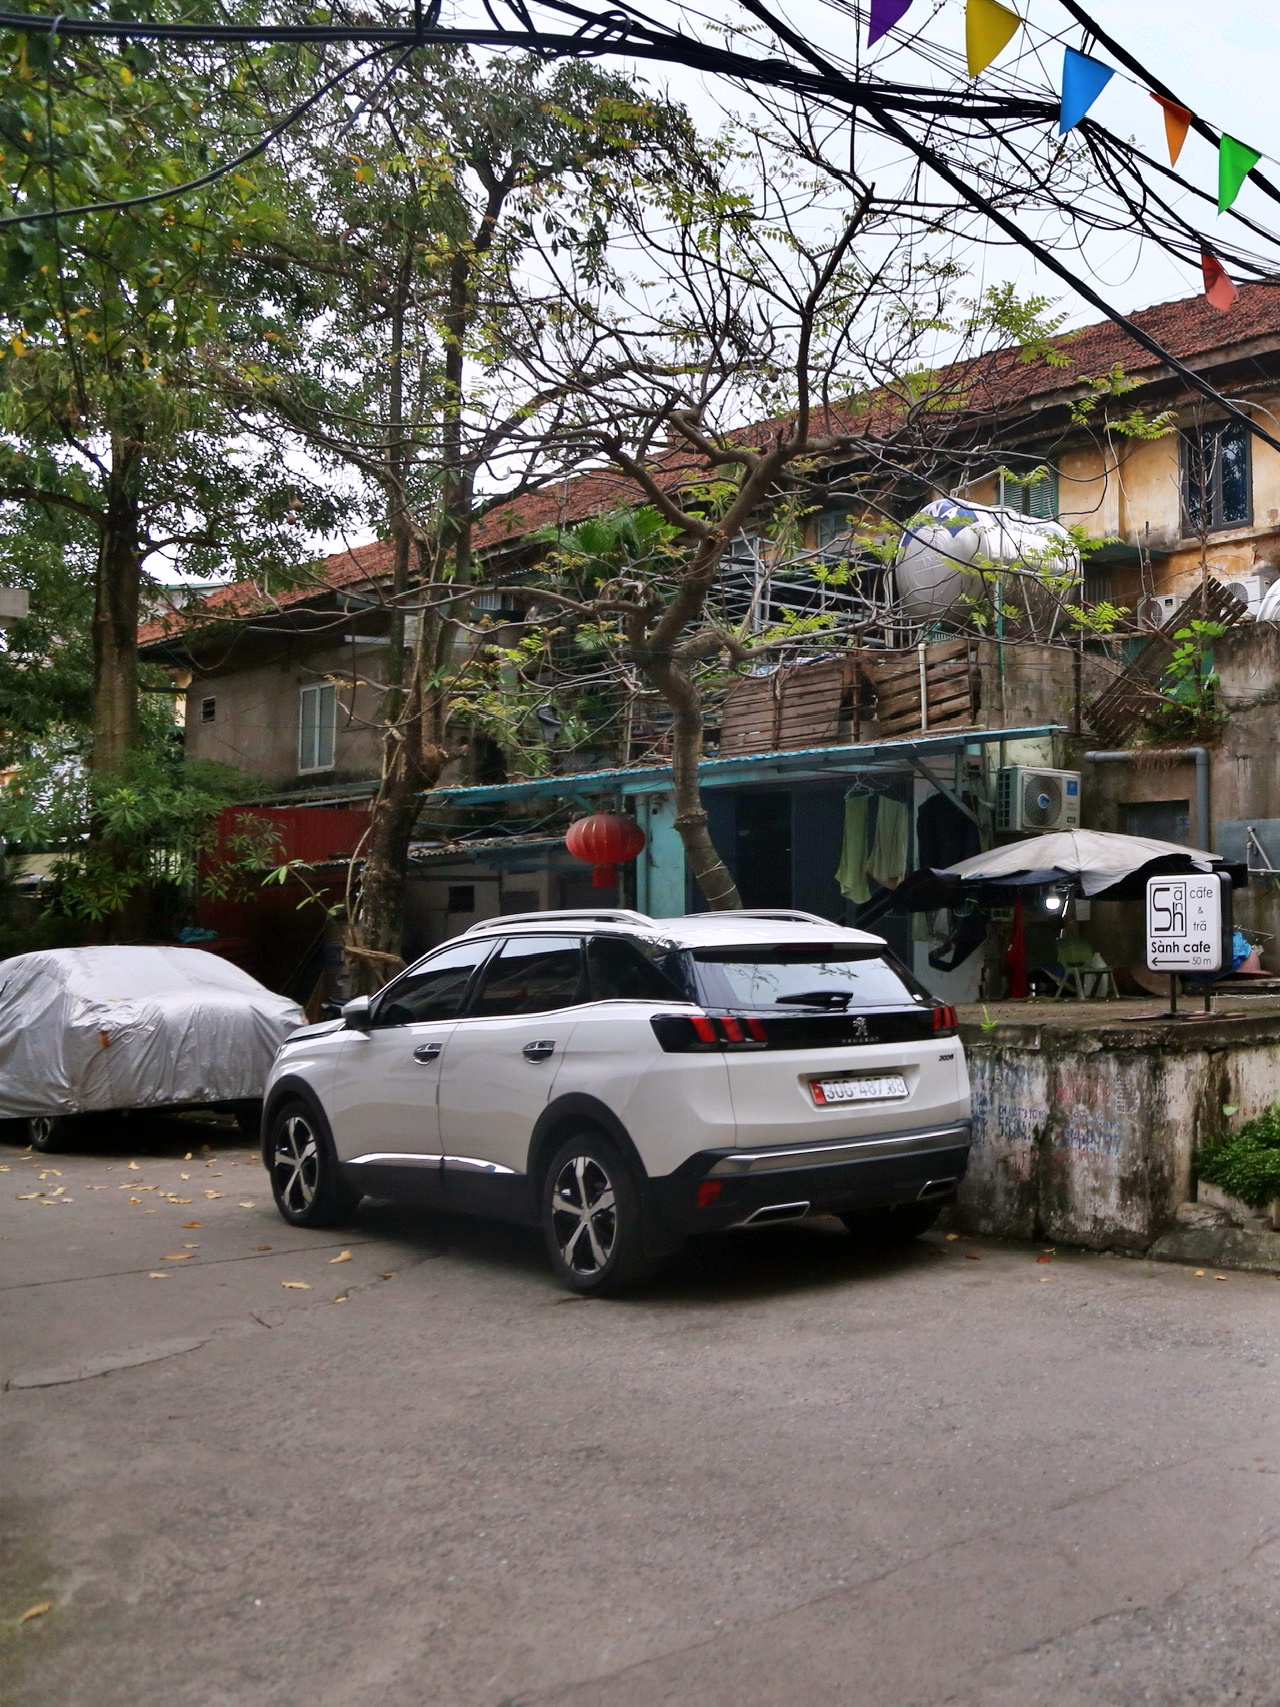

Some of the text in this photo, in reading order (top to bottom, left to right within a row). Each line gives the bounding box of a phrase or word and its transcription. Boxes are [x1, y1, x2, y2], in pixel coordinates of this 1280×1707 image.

[1197, 906, 1204, 914] &
[1151, 940, 1211, 953] Sành cafe
[1192, 957, 1201, 965] 50
